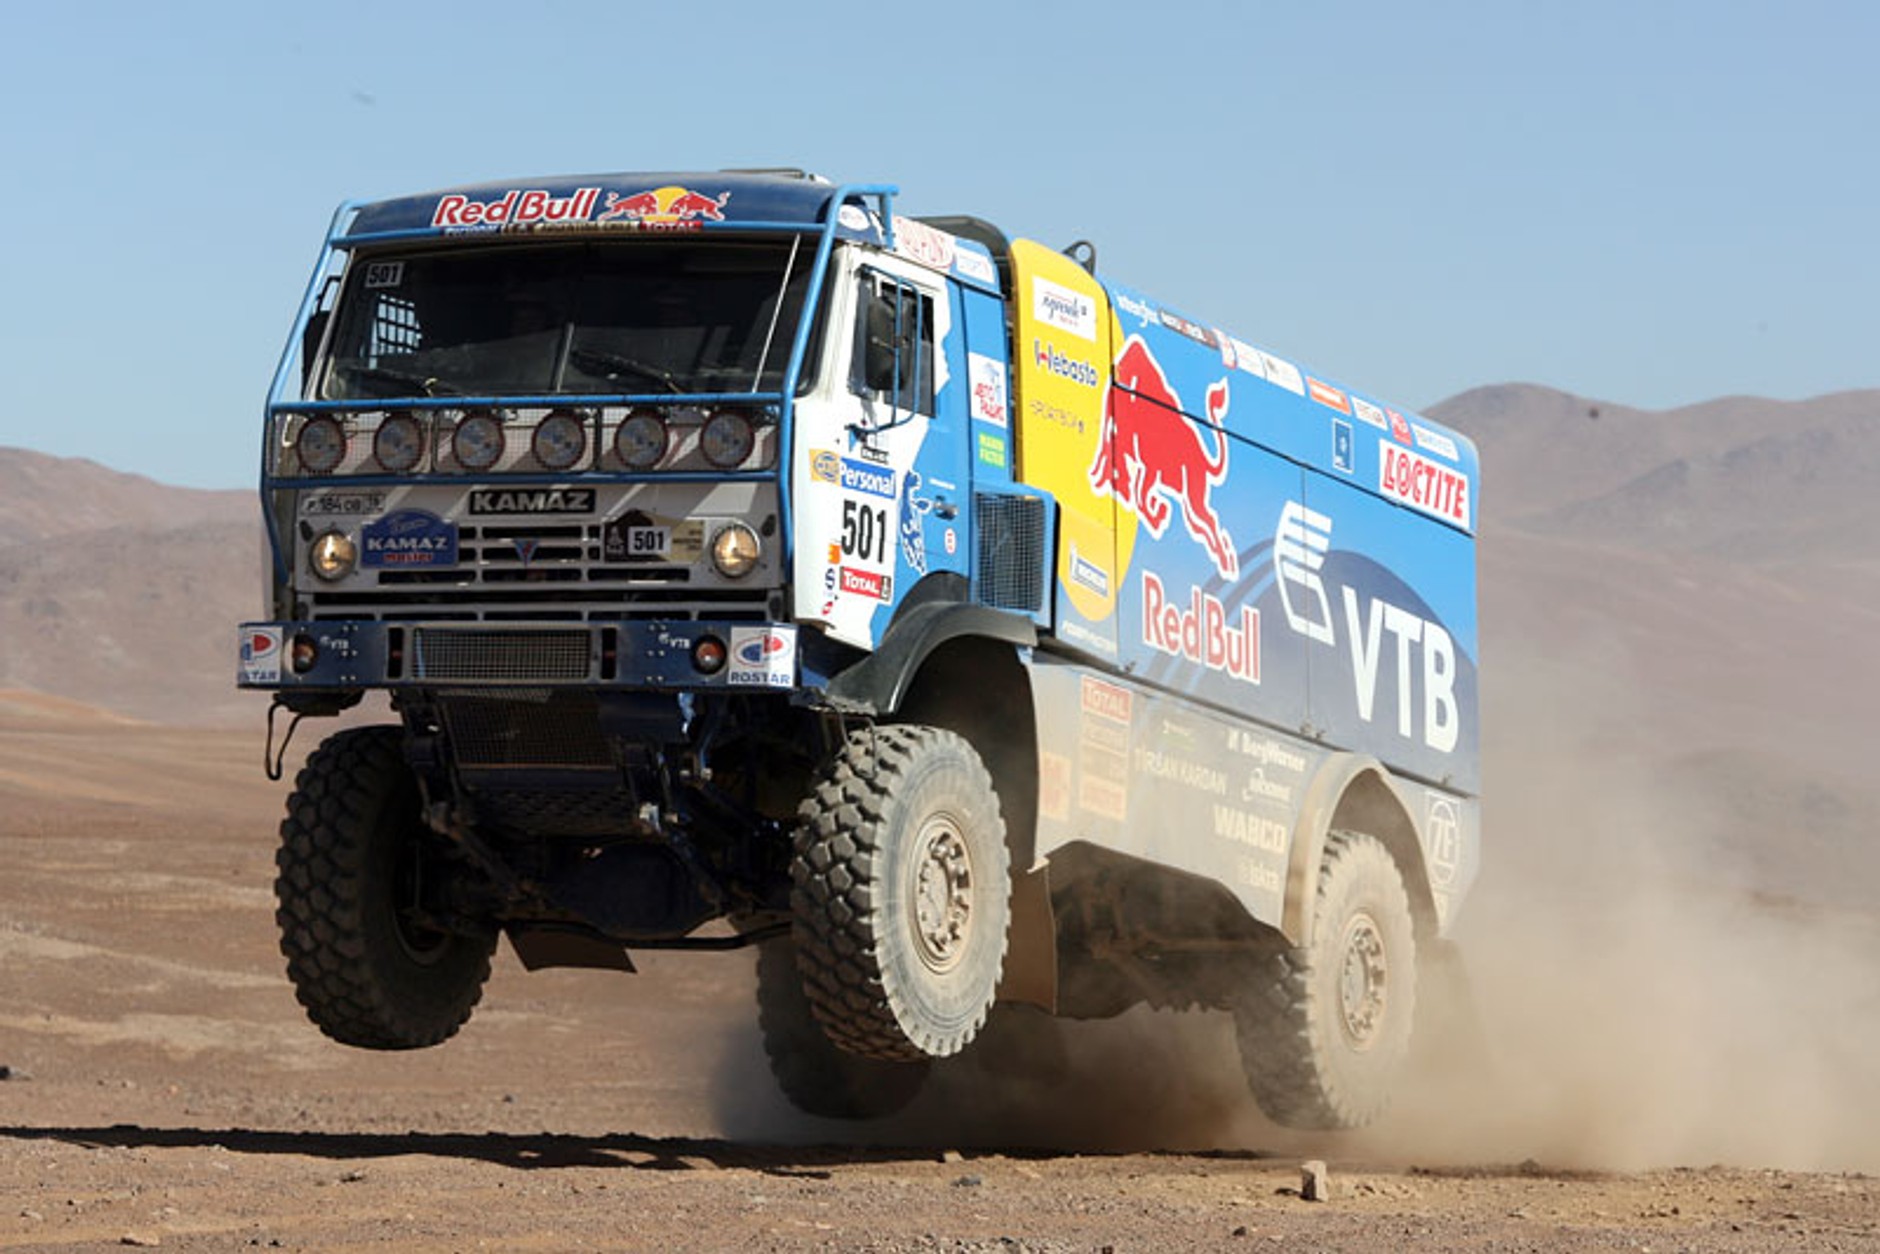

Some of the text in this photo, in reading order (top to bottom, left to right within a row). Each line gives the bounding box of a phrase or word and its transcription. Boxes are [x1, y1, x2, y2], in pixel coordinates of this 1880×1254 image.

[432, 188, 601, 226] Red Bull
[369, 265, 398, 285] 501
[840, 462, 895, 496] Personal
[1383, 447, 1466, 519] LOCTITE
[473, 491, 593, 511] KAMAZ
[368, 537, 448, 551] KAMAZ
[634, 531, 665, 551] 501
[841, 499, 886, 564] 501
[843, 570, 880, 595] TOTAL
[1142, 569, 1202, 663] Red
[1203, 593, 1261, 685] Bull
[731, 672, 790, 684] ROSTAR
[1341, 584, 1459, 753] VTB
[1085, 682, 1128, 720] TOTAL
[1214, 804, 1287, 853] WABCO
